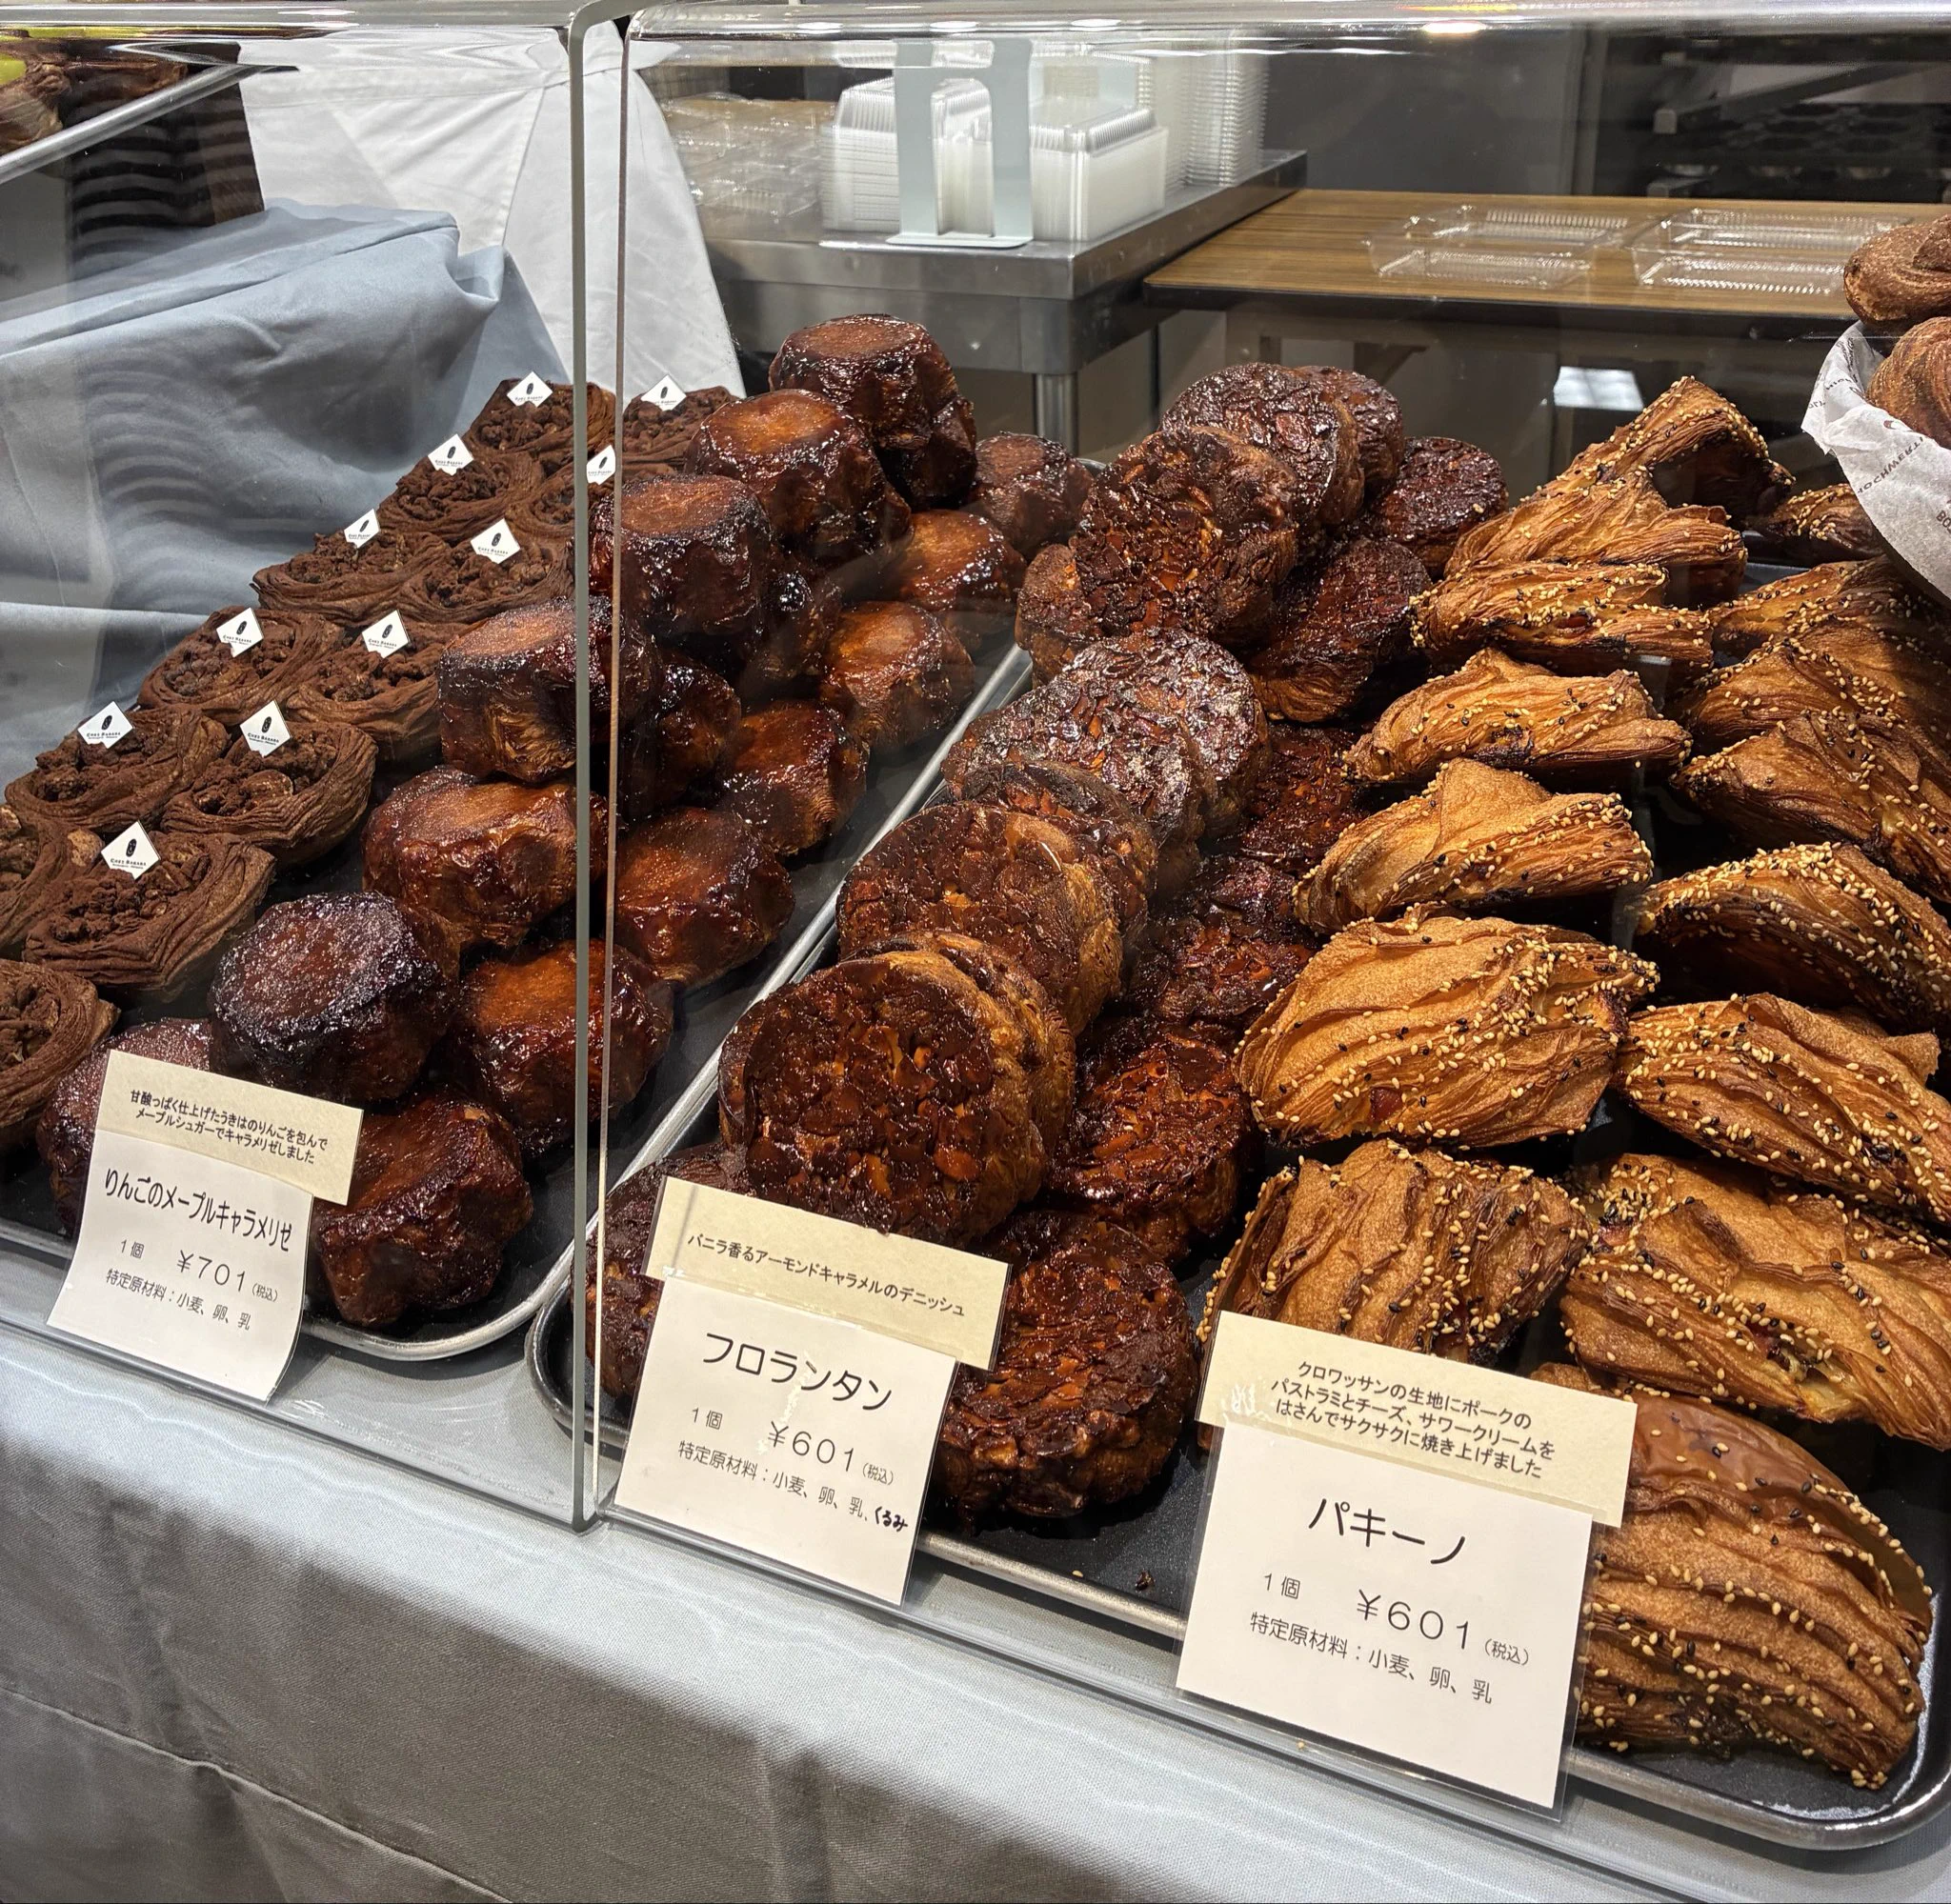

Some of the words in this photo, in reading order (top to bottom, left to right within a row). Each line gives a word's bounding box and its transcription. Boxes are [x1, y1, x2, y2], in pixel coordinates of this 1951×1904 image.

[131, 1089, 328, 1151] 甘酸っぱく仕上げたうきはのりんごを包んで
[136, 1108, 315, 1164] メープルシュガーでキャラメリゼしました
[105, 1168, 292, 1252] りんごのメープルキャラメリゼ
[177, 1250, 246, 1292] ¥701
[688, 1233, 965, 1316] バニラ香るアーモンドキャラメルのデニッシュ
[703, 1333, 892, 1410] フロランタン
[1297, 1361, 1532, 1430] クロワッサンの生地にポークの
[768, 1420, 855, 1473] ¥601
[1271, 1378, 1556, 1460] パストラミとチーズ、サワークリームを
[1276, 1398, 1542, 1479] はさんでサクサクに焼き上げました
[1308, 1497, 1465, 1565] パキーノ
[1357, 1589, 1469, 1650] ¥601
